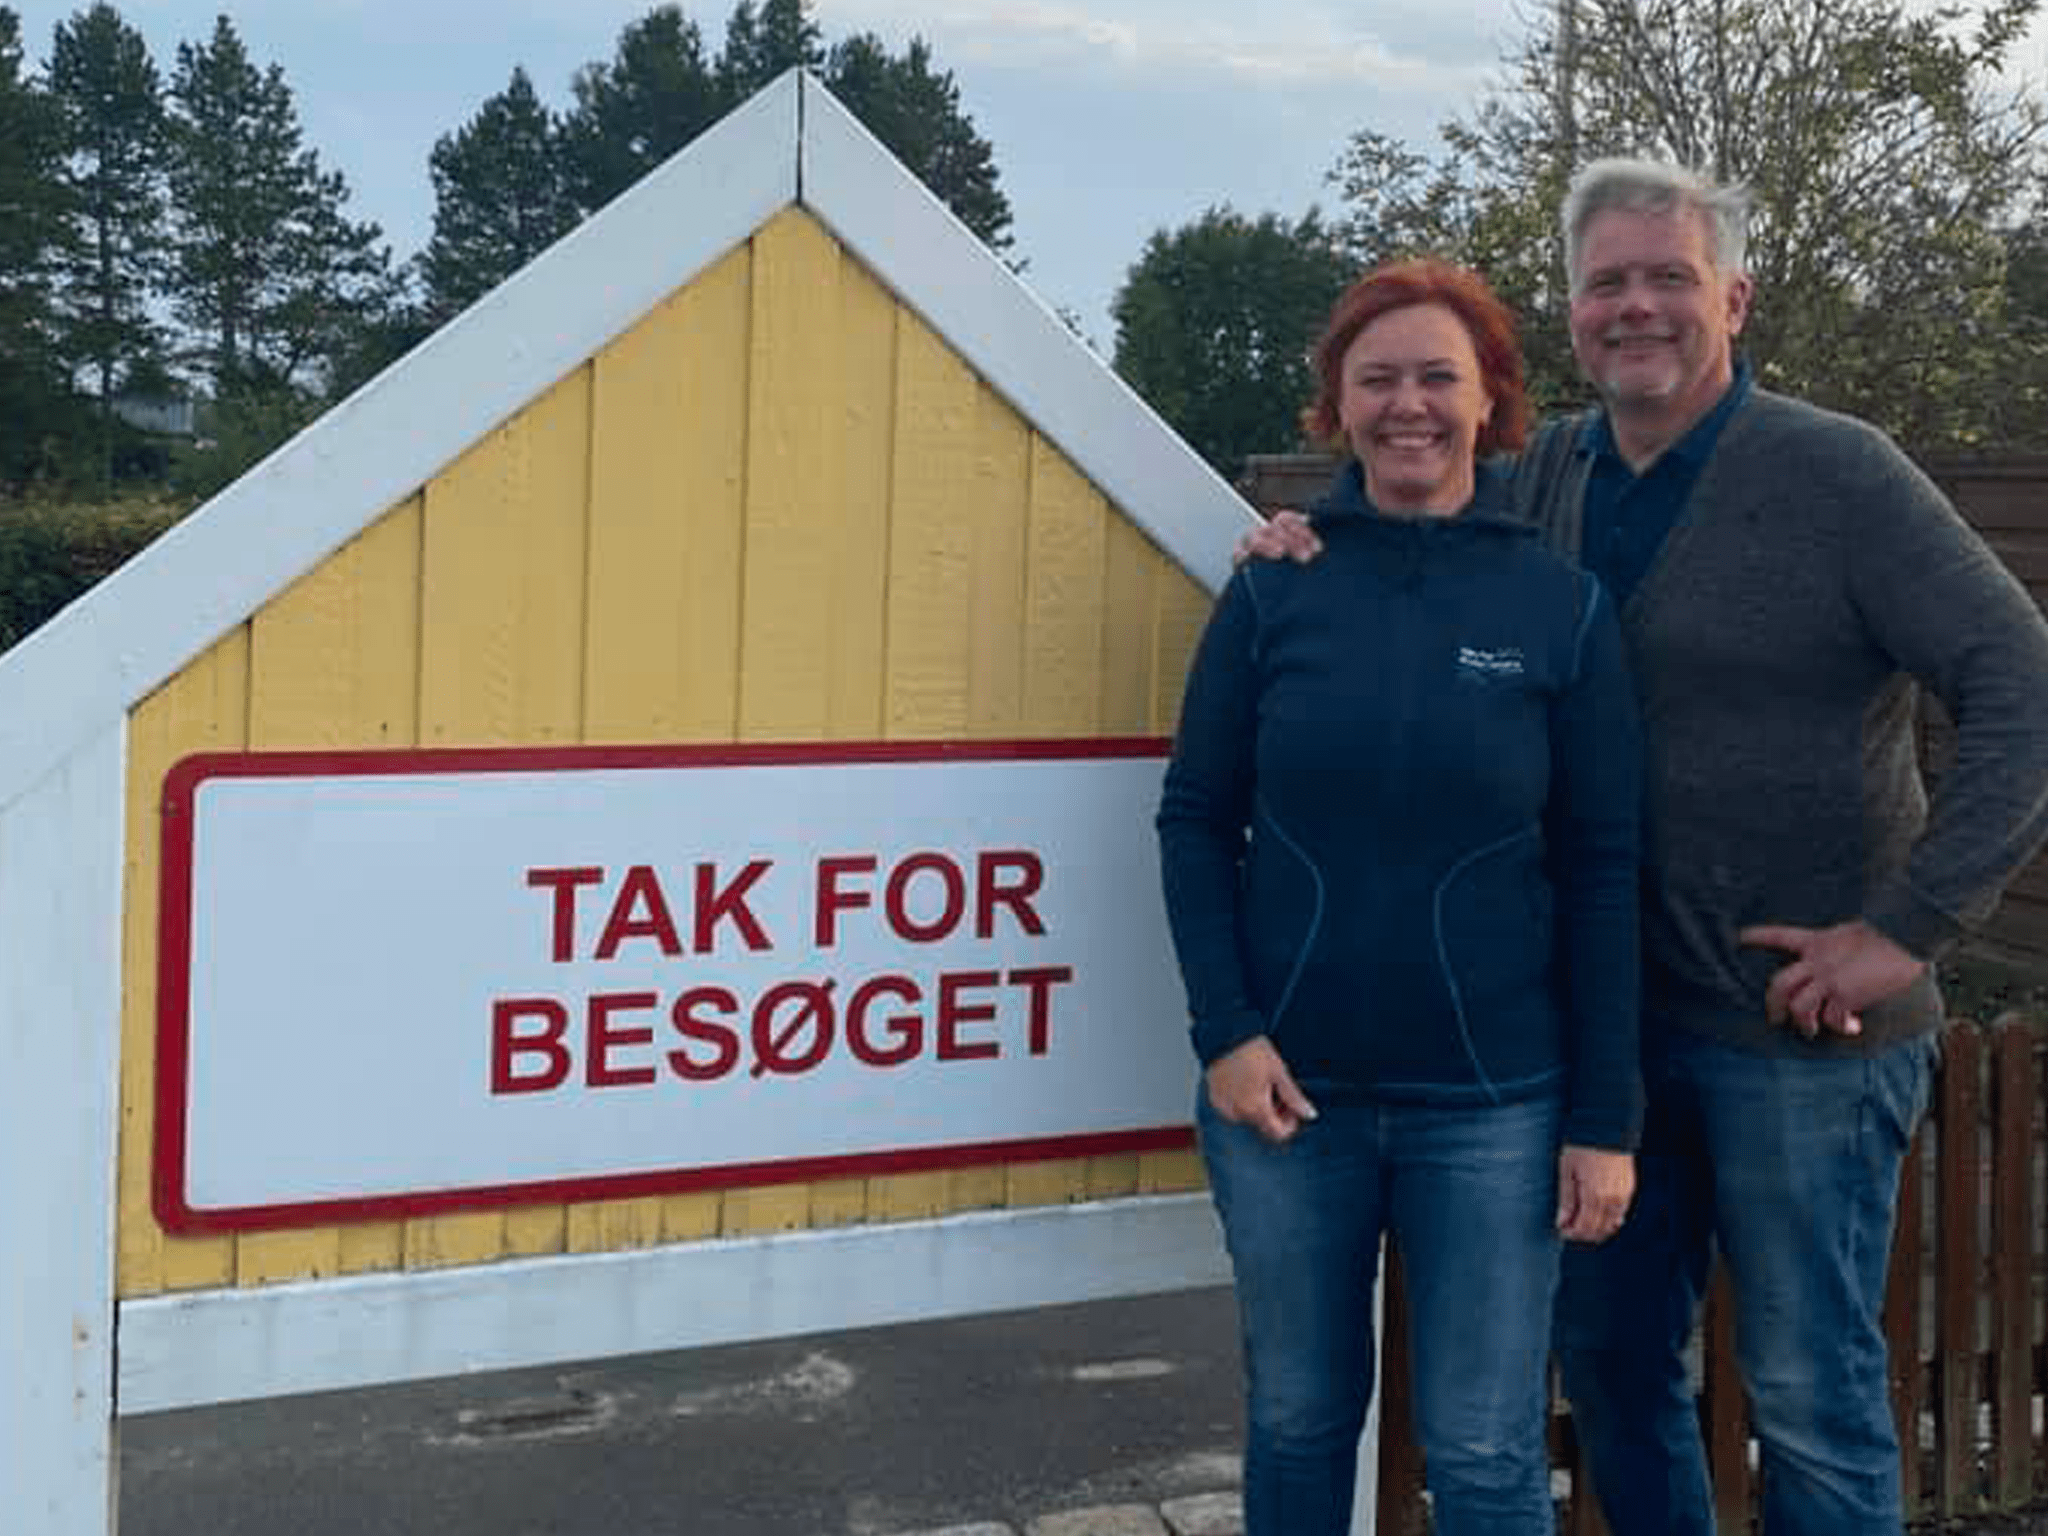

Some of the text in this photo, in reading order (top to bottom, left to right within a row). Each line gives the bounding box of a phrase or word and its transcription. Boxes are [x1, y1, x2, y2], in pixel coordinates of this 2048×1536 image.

[526, 850, 1046, 964] TAK FOR
[490, 965, 1073, 1095] BESØGET
